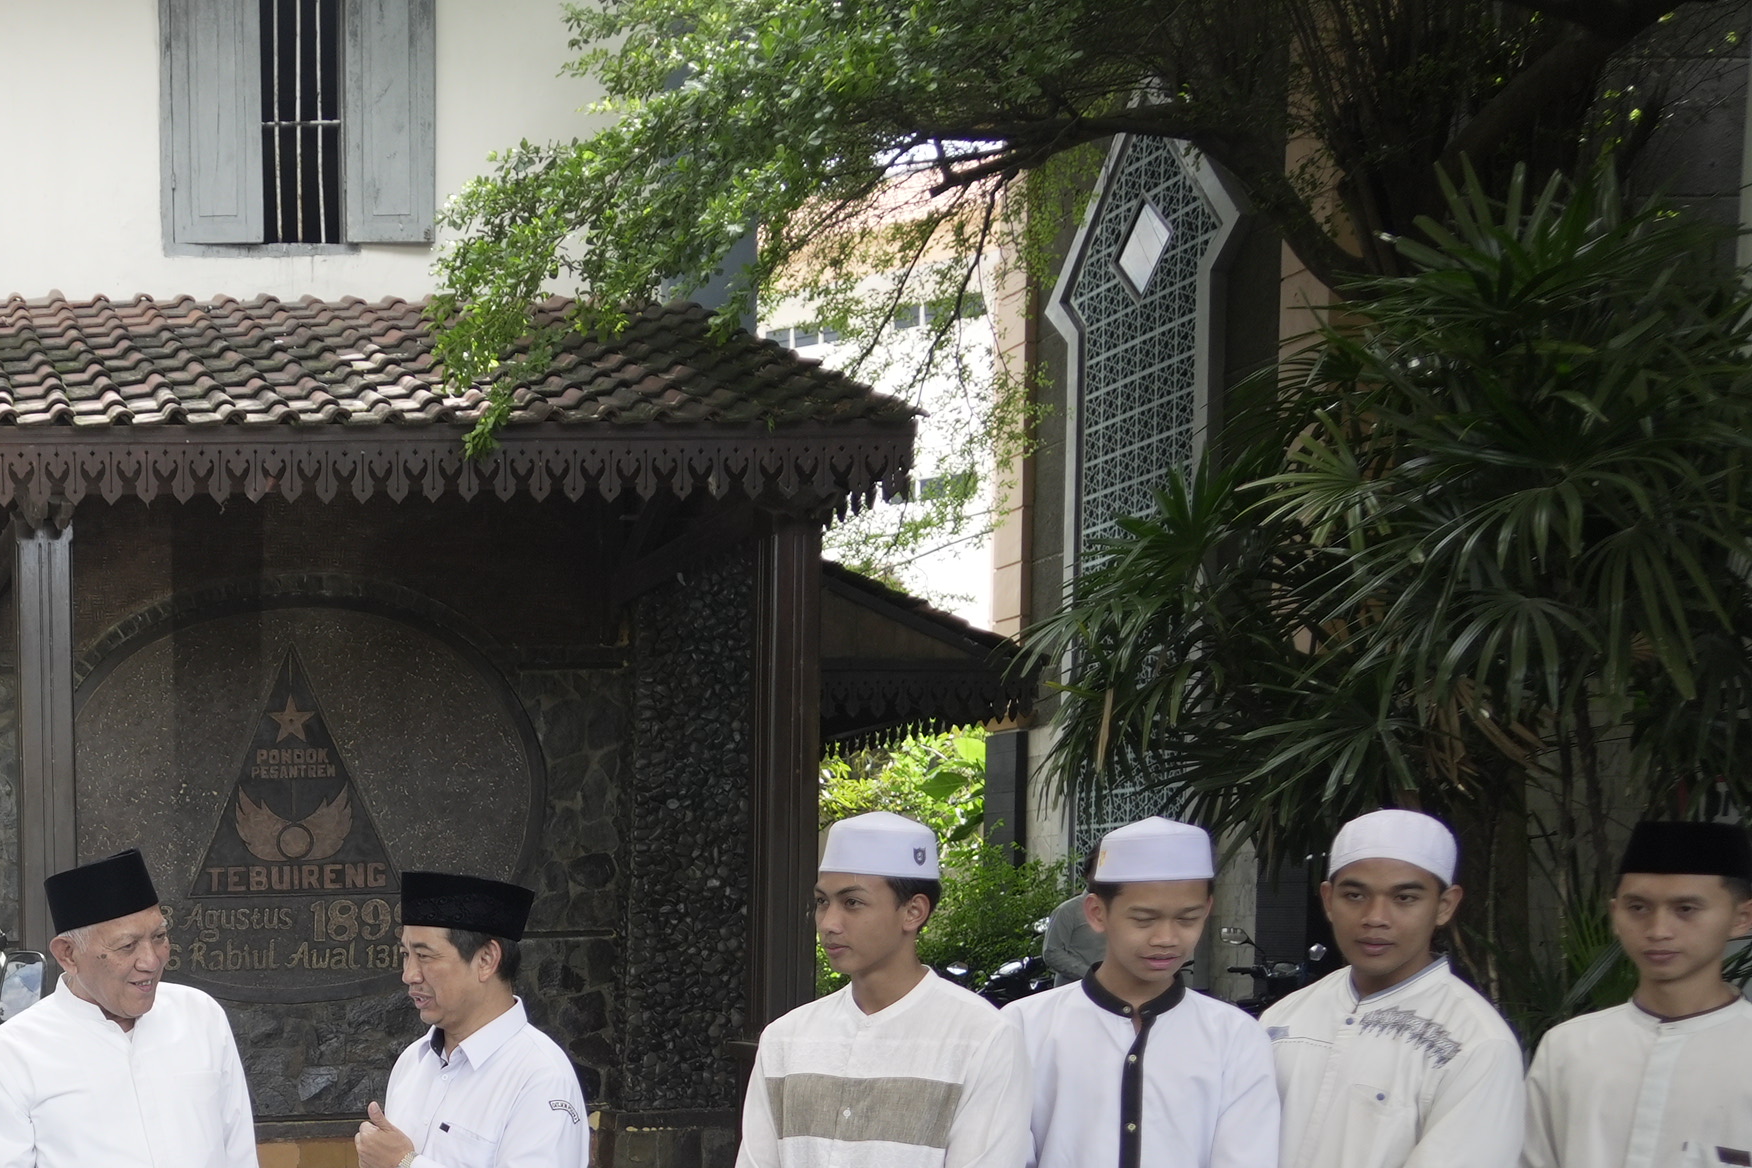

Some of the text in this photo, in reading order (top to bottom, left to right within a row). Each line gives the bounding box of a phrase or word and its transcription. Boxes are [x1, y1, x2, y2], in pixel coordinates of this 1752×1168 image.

[256, 748, 329, 765] PONDOK
[251, 764, 336, 779] PESANTREN
[206, 862, 386, 892] TEBUIRENG
[179, 902, 294, 943] Agustus
[310, 898, 402, 943] 189
[284, 941, 361, 970] Awal
